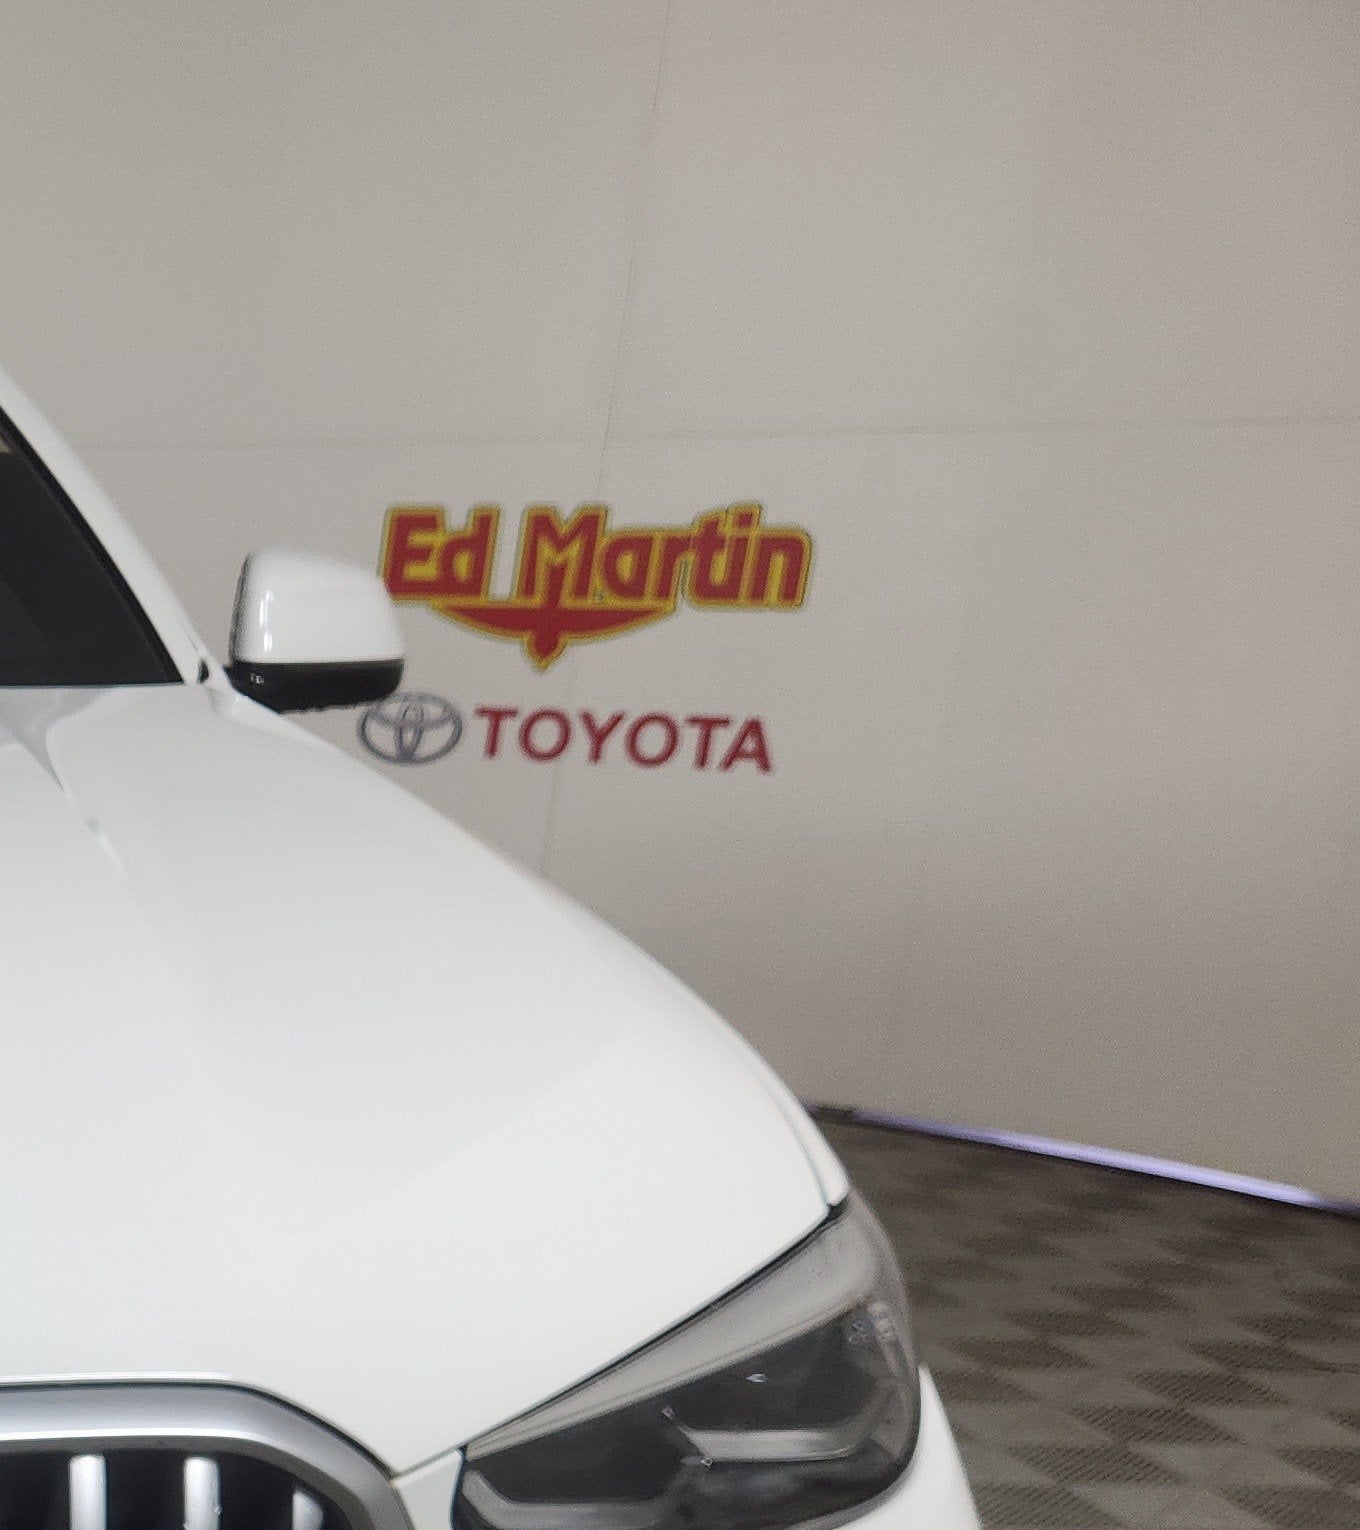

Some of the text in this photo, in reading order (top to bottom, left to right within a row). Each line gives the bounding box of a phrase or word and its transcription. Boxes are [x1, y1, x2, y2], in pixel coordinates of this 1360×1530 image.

[382, 503, 813, 607] Ed Martin
[475, 705, 772, 775] TOYOTA
